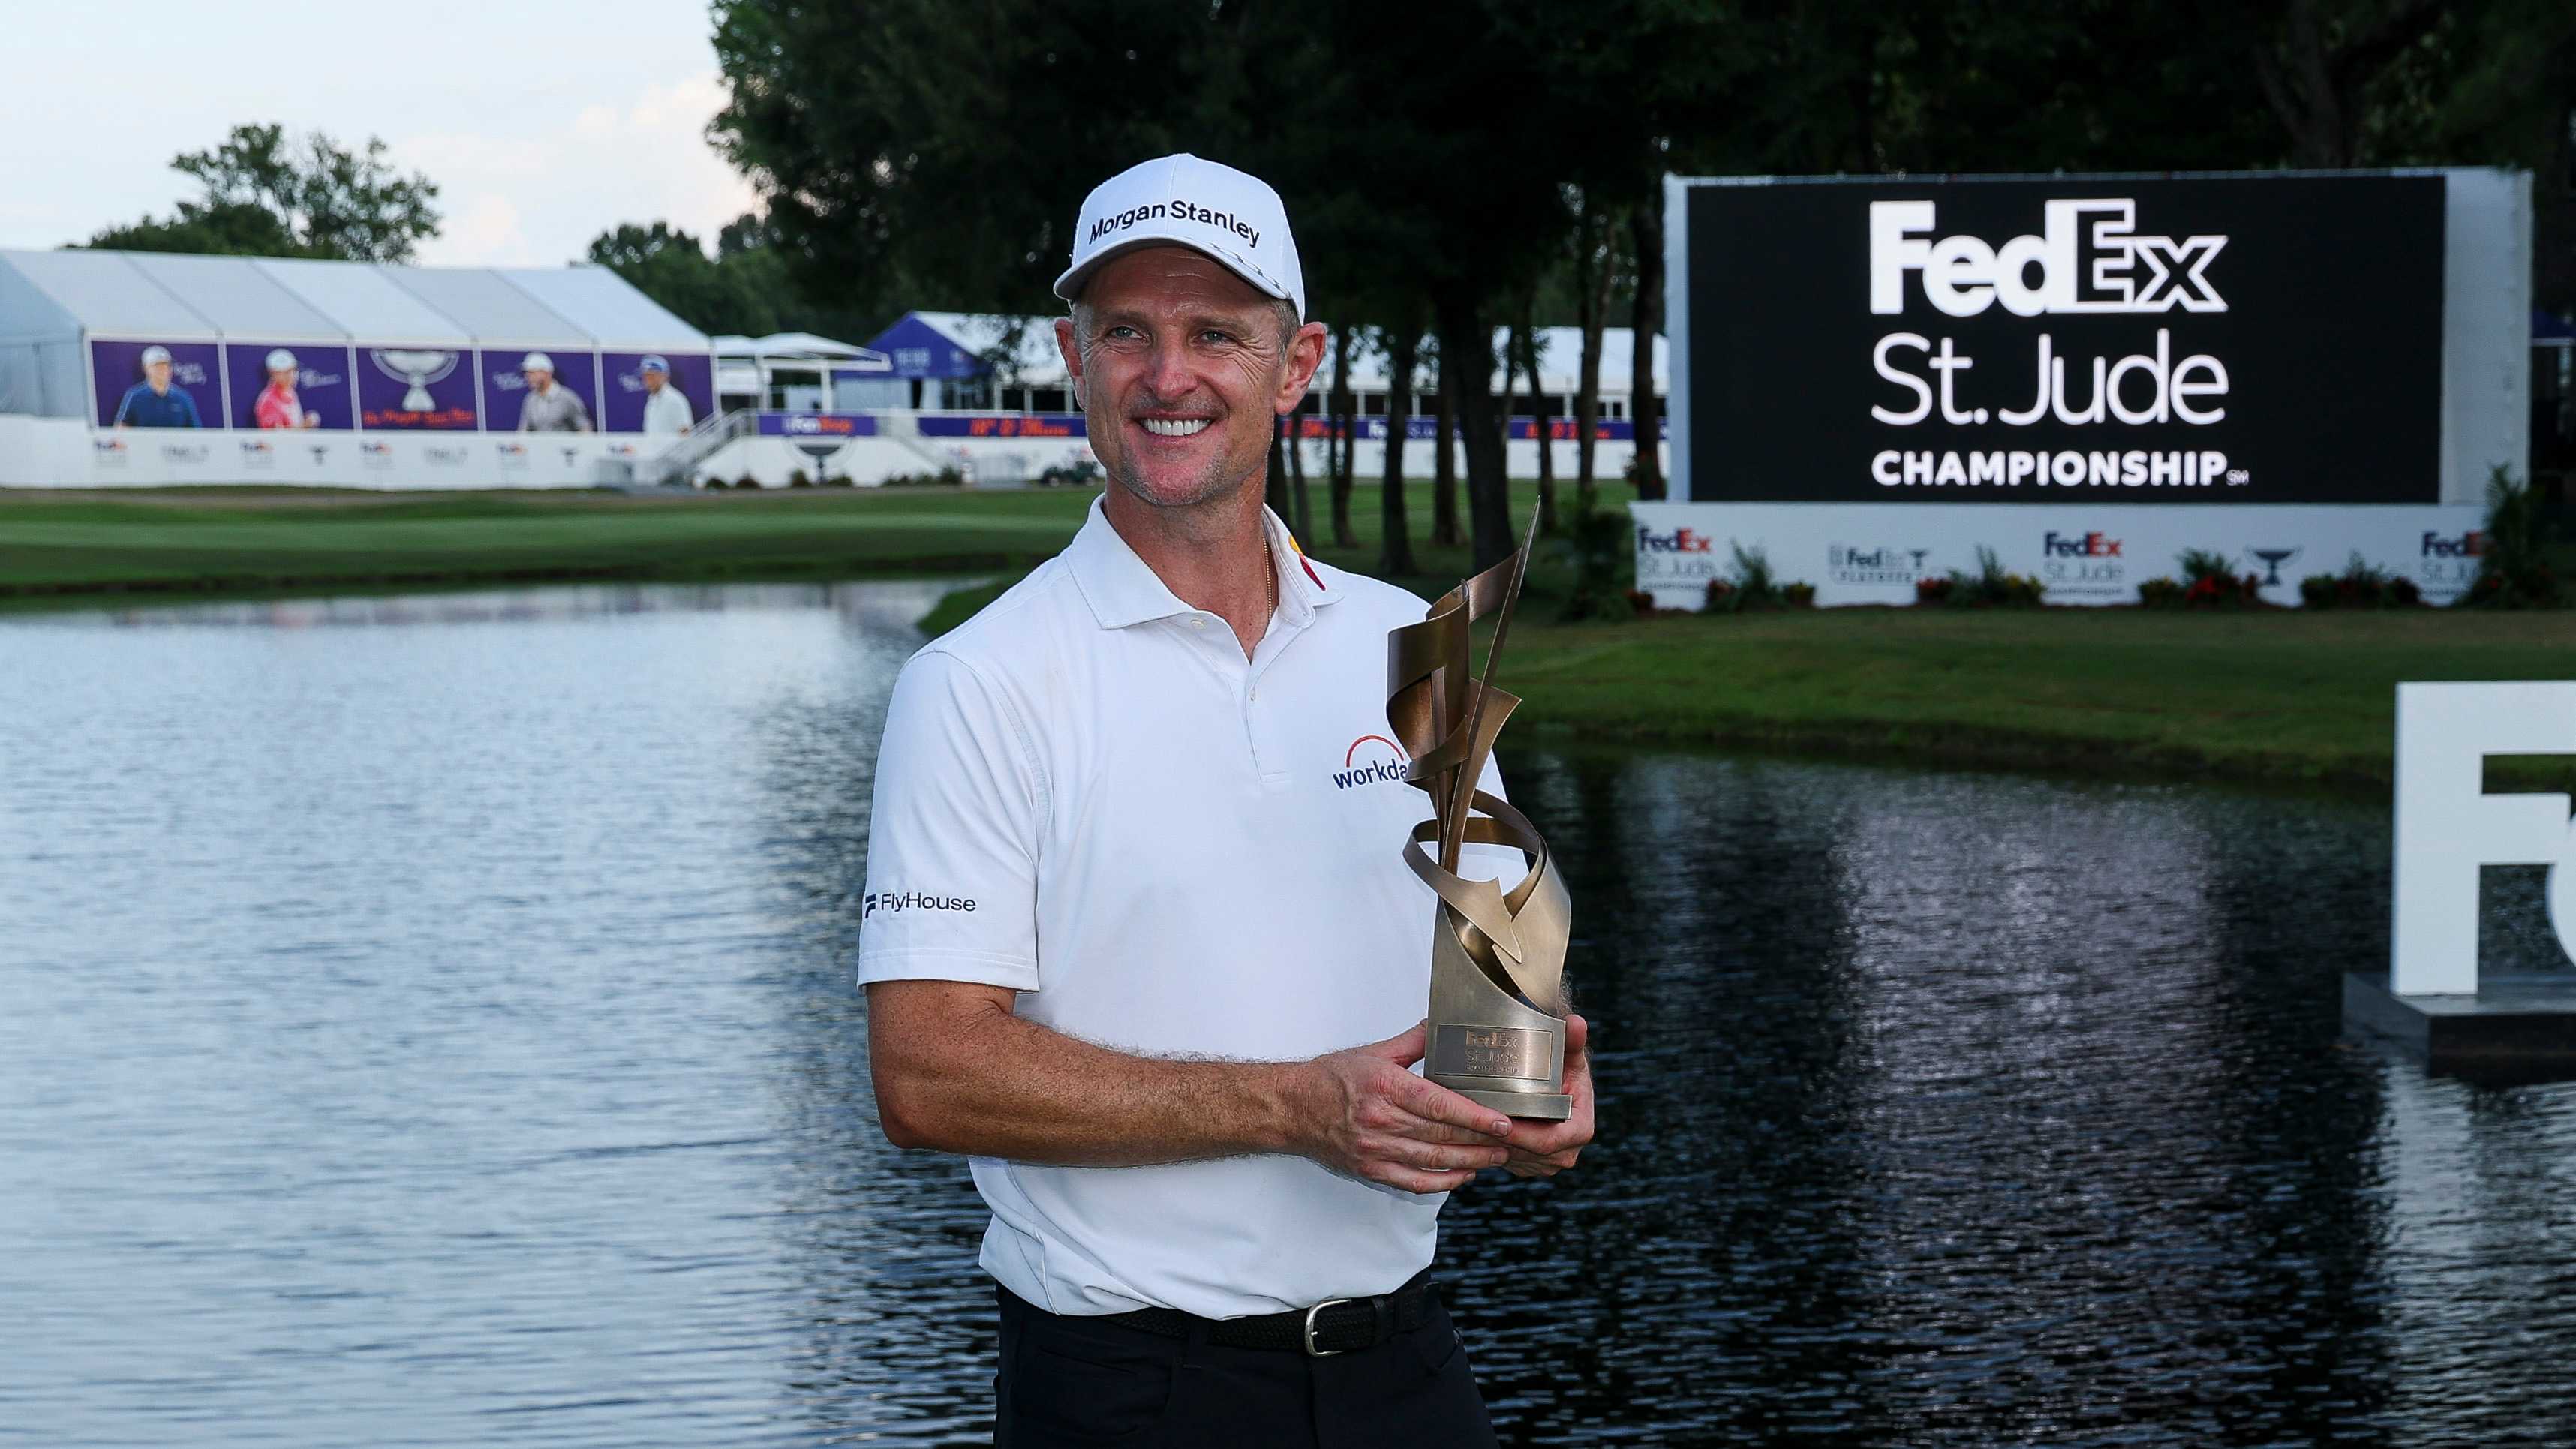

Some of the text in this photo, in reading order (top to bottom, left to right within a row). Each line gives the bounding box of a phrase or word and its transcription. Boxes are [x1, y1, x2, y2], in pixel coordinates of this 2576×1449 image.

[1089, 200, 1261, 248] Morgan Stanley
[1870, 199, 2229, 317] FedEx
[1871, 328, 2229, 425] St. Jude
[1871, 449, 2228, 486] CHAMPIONSHIP
[1638, 526, 1712, 553] FedEx
[2044, 531, 2122, 557] FedEx
[2422, 531, 2485, 557] FedE
[1333, 758, 1408, 789] workda
[881, 892, 976, 912] FlyHouse
[1465, 1030, 1519, 1048] FedEx
